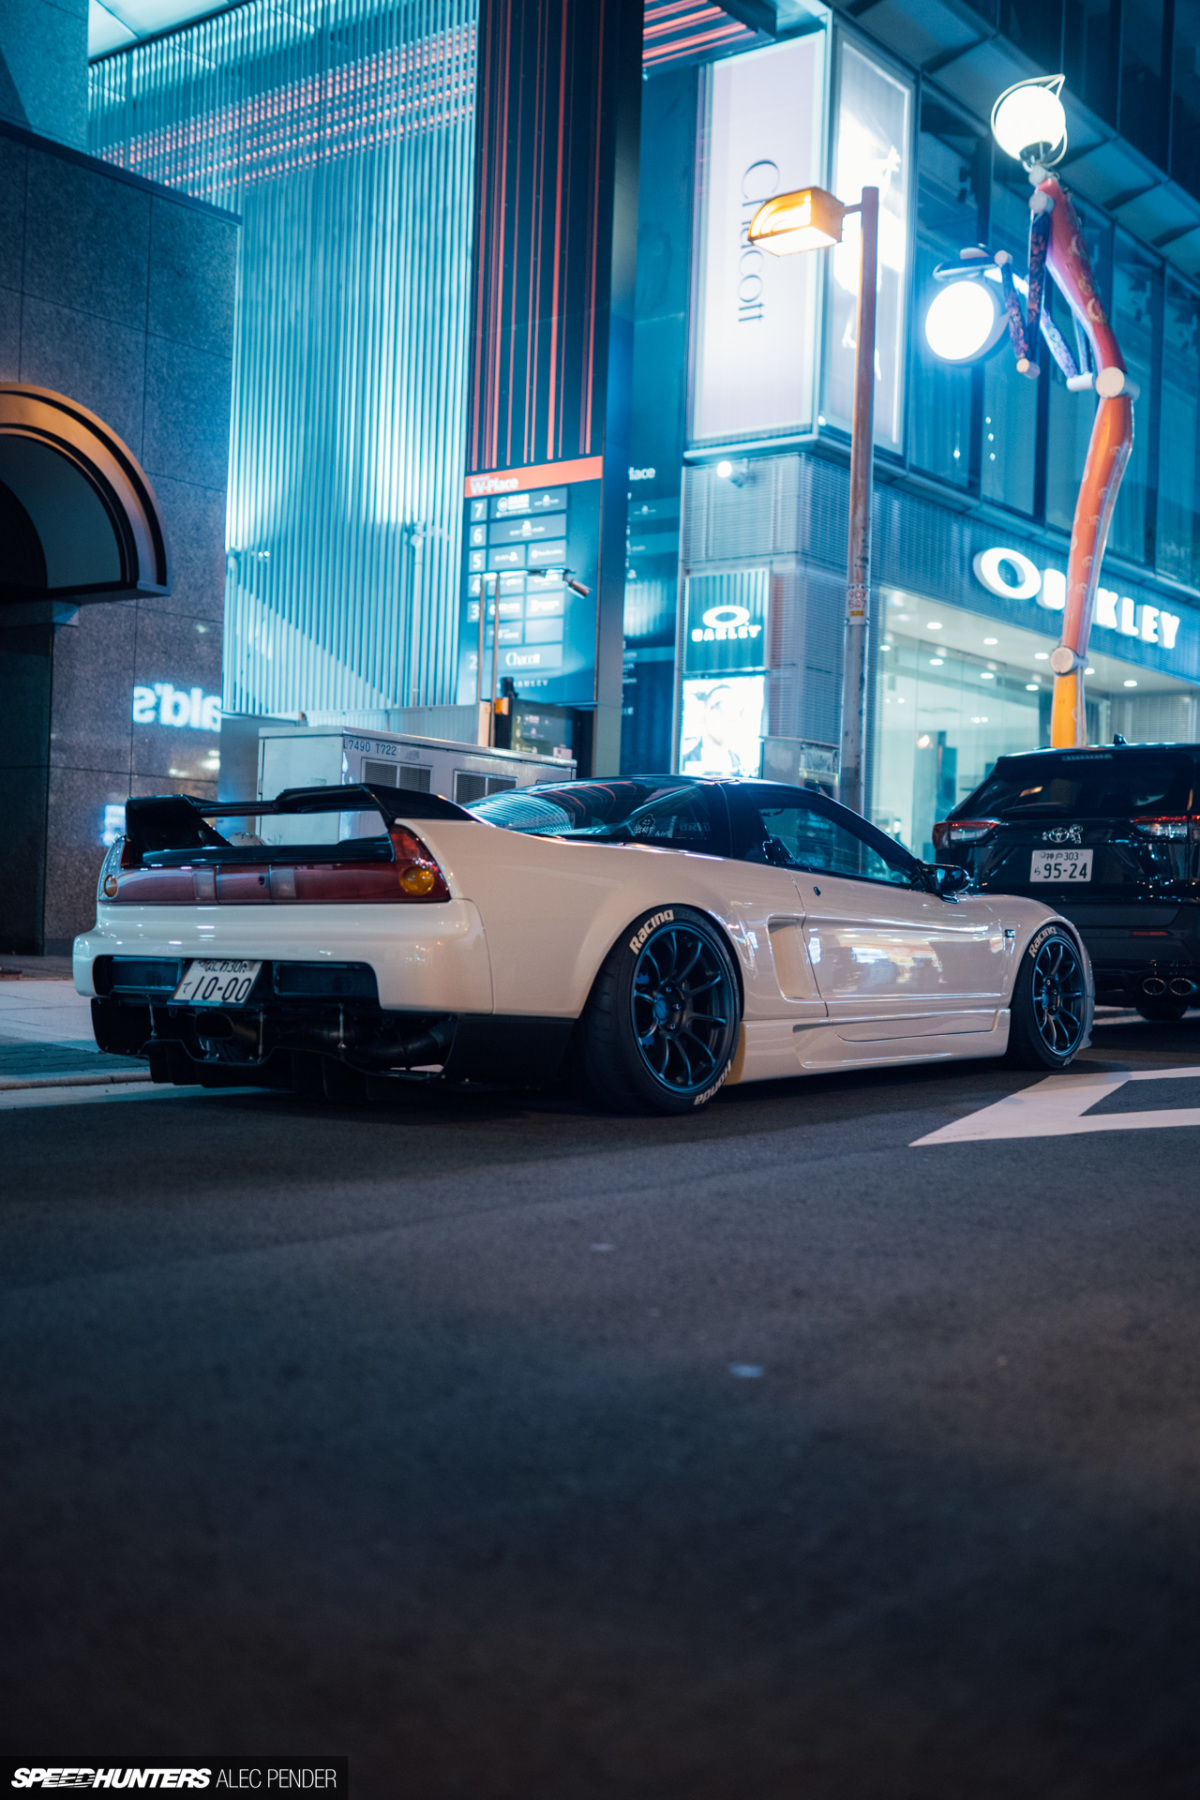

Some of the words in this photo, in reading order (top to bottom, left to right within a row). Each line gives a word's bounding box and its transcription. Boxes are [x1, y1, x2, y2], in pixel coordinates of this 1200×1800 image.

[475, 503, 483, 518] 7
[473, 528, 482, 543] 6
[473, 554, 482, 569] 5
[1043, 862, 1087, 879] 95-24
[629, 909, 674, 955] Racing
[191, 976, 252, 1002] 10-00
